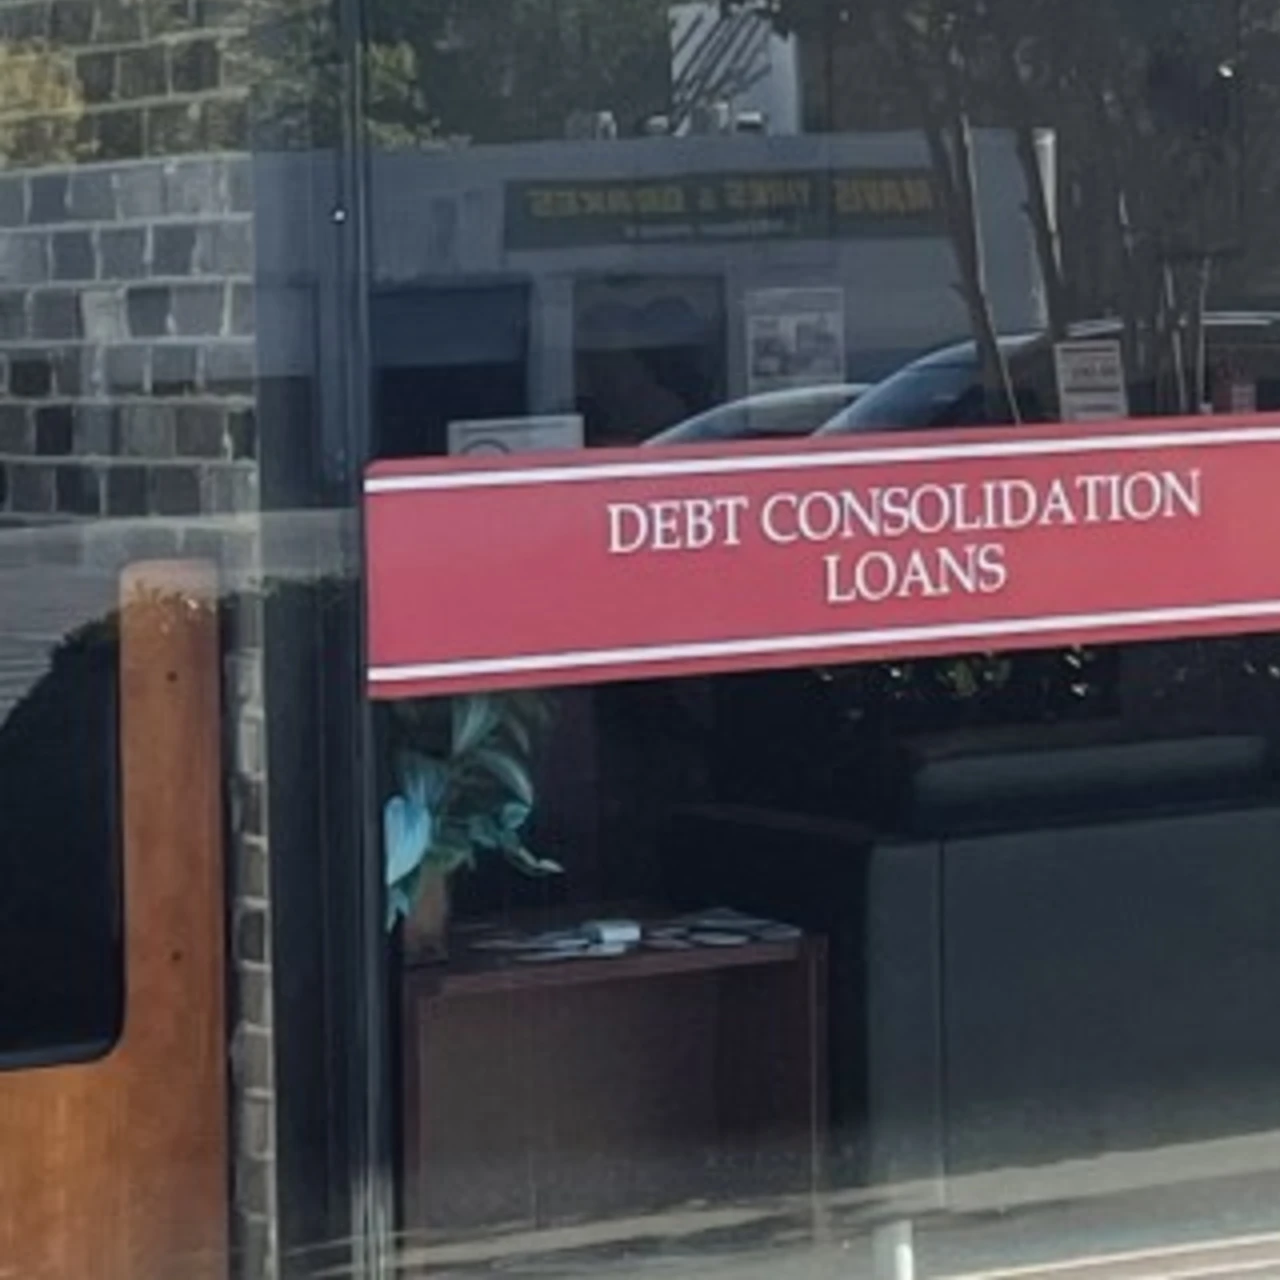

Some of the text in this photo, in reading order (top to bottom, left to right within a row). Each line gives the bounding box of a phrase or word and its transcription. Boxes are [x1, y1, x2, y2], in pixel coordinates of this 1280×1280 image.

[607, 468, 1202, 553] DEBT CONSOLIDATION
[823, 543, 1007, 603] LOANS
